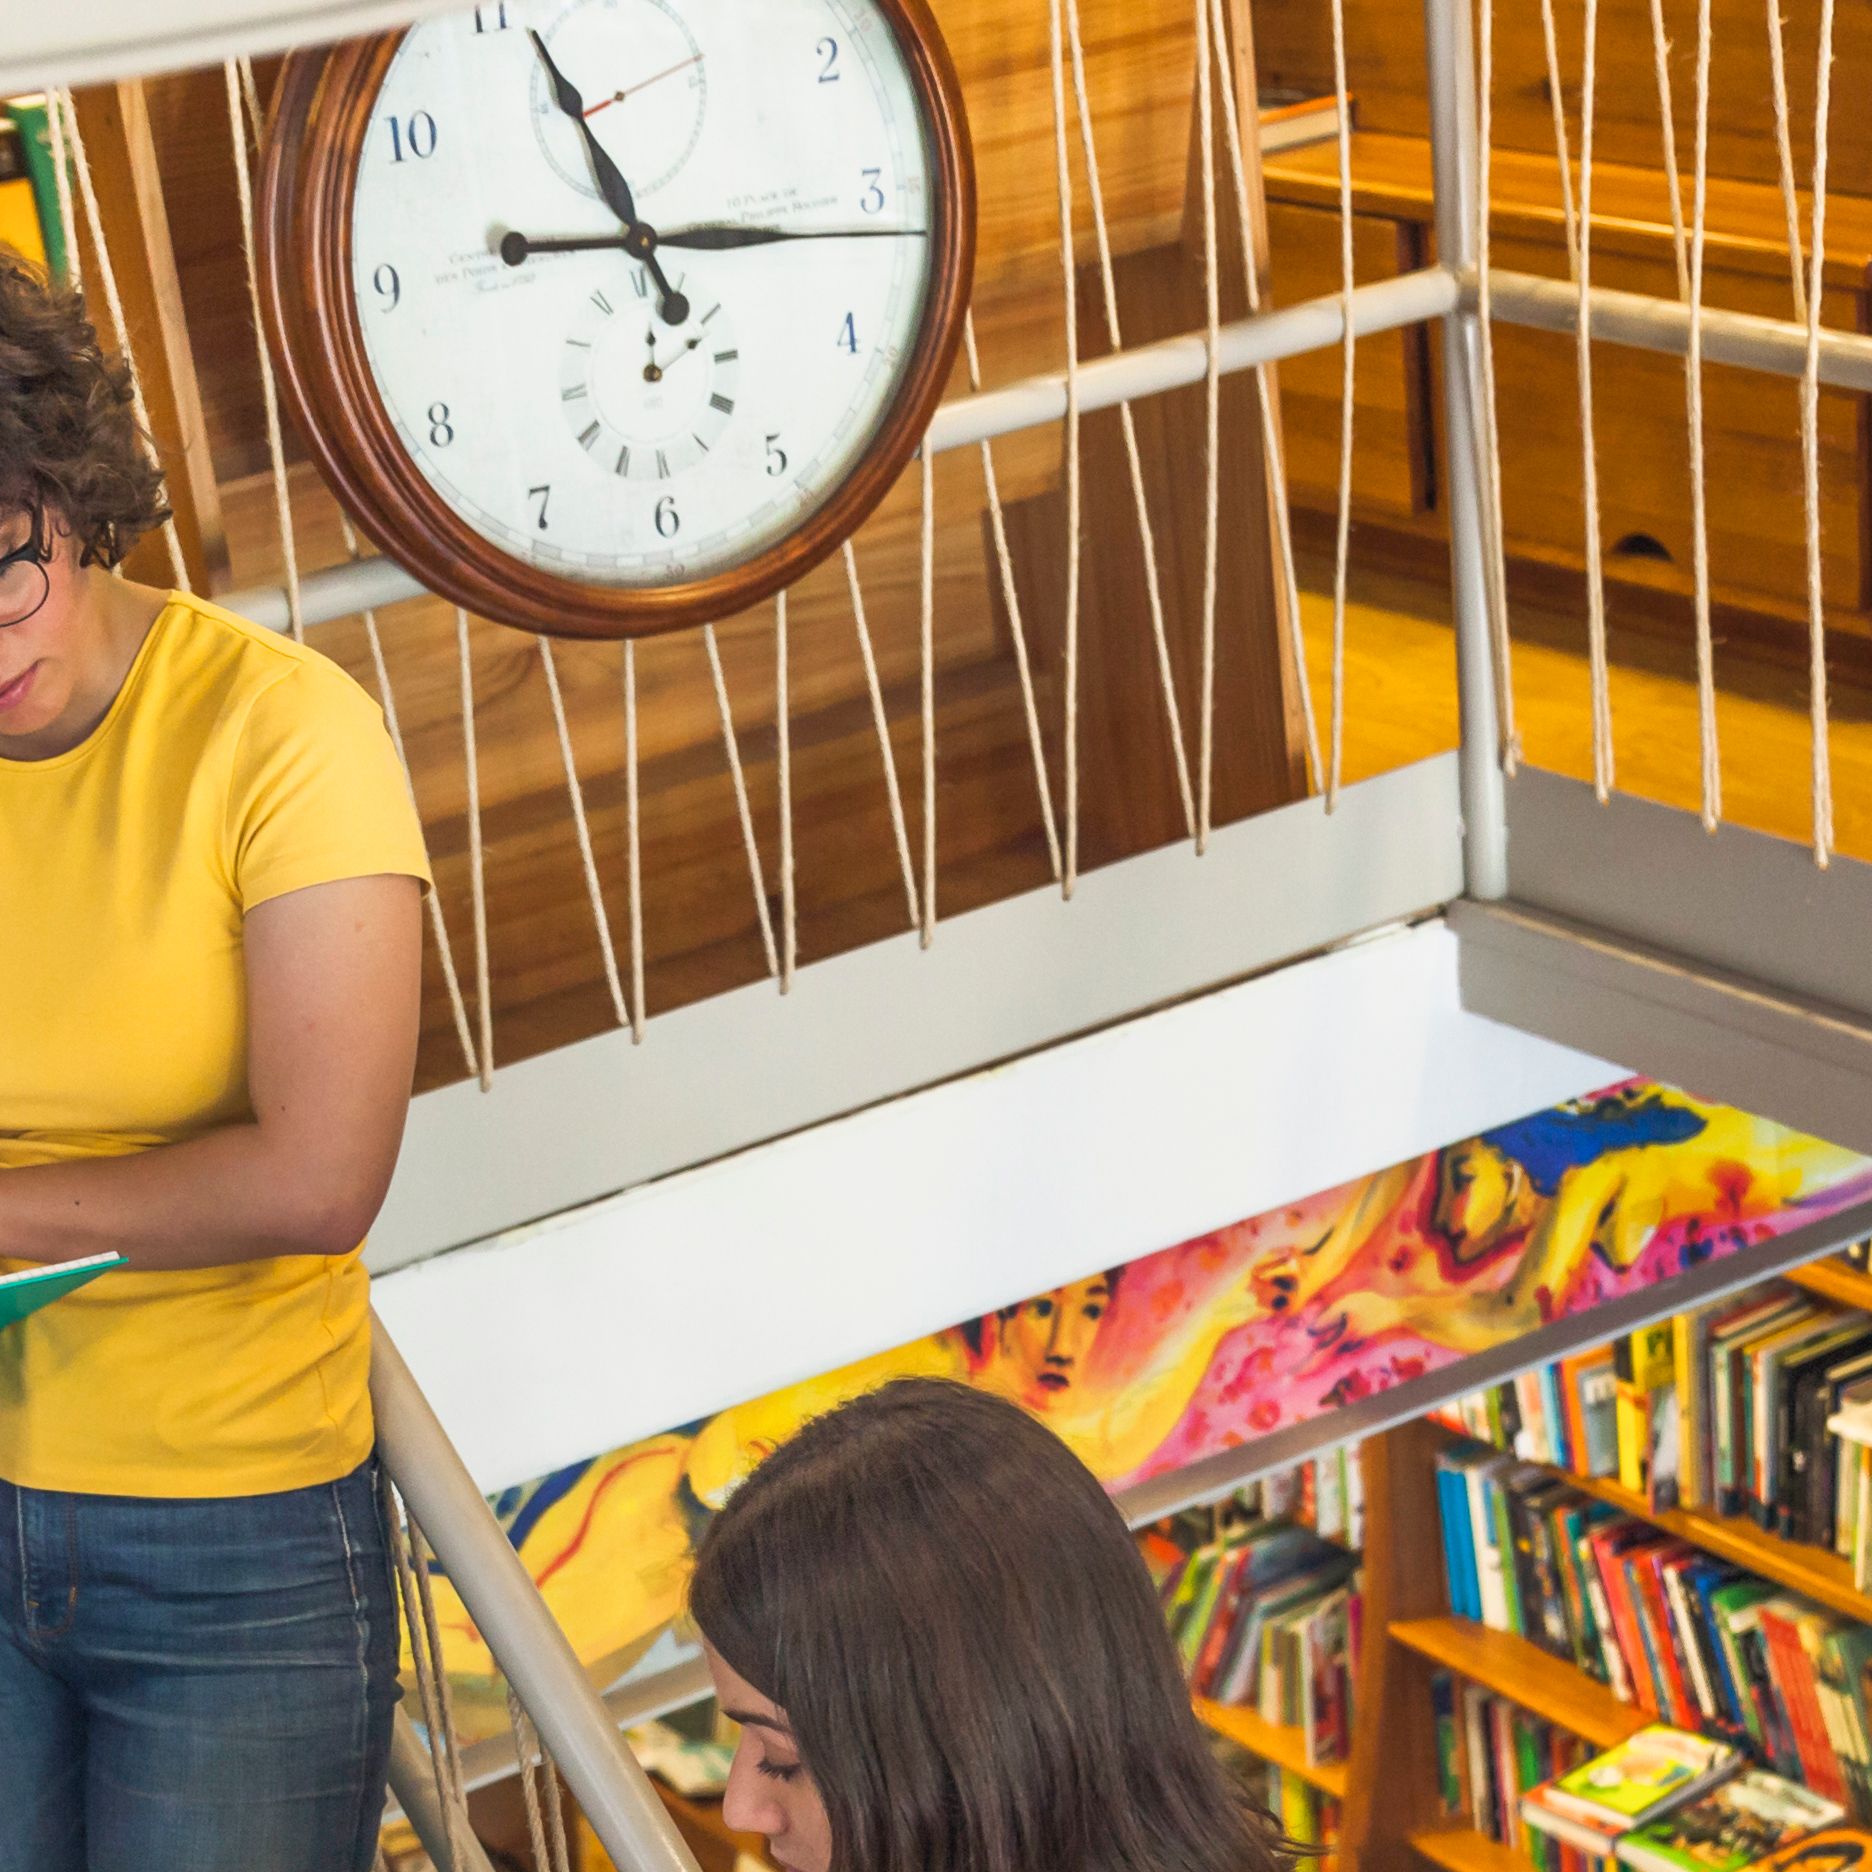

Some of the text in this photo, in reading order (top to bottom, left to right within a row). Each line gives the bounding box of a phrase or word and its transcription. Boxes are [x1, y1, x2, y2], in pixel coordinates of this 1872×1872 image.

[816, 37, 840, 84] 2
[386, 111, 438, 165] 10
[860, 168, 885, 214] 3
[373, 264, 400, 313] 9
[837, 311, 860, 356] 4
[428, 401, 454, 449] 8
[764, 433, 788, 477] 5
[528, 485, 552, 530] 7
[654, 496, 680, 540] 6
